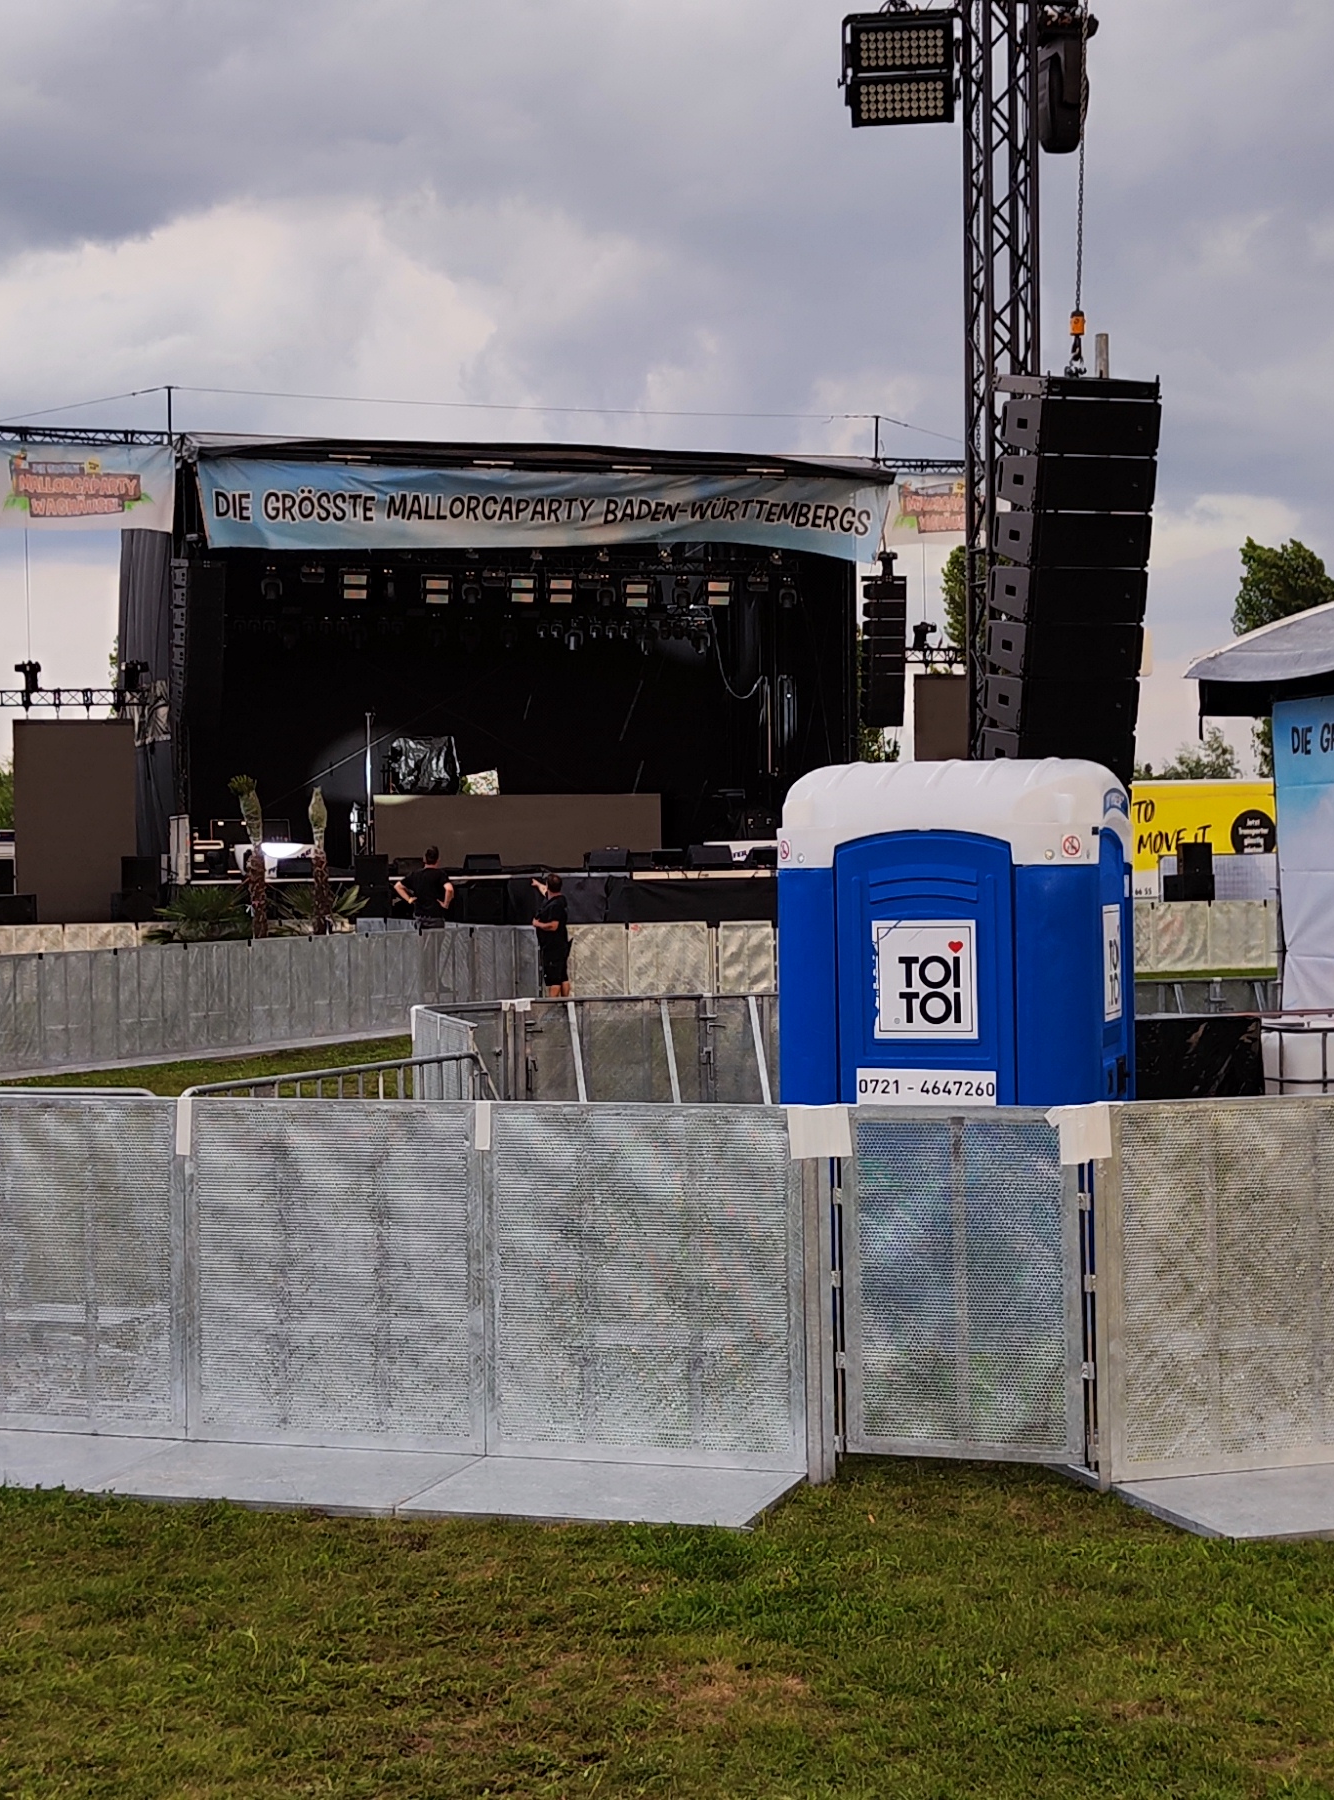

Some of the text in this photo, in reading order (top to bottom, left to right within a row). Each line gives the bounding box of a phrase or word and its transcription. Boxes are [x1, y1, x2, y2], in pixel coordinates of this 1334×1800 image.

[213, 490, 252, 521] DIE
[263, 487, 376, 523] GRÖSSTE
[386, 491, 596, 524] MALLORCAPARTY
[603, 496, 872, 537] BADEN-WÜRTTEMBERGS
[1291, 725, 1313, 755] DIE
[1133, 799, 1155, 823] TO
[1137, 828, 1187, 854] MOVE
[898, 955, 961, 989] TOI
[899, 991, 962, 1025] TOI
[858, 1079, 900, 1095] 0721
[920, 1079, 995, 1097] 4647260
